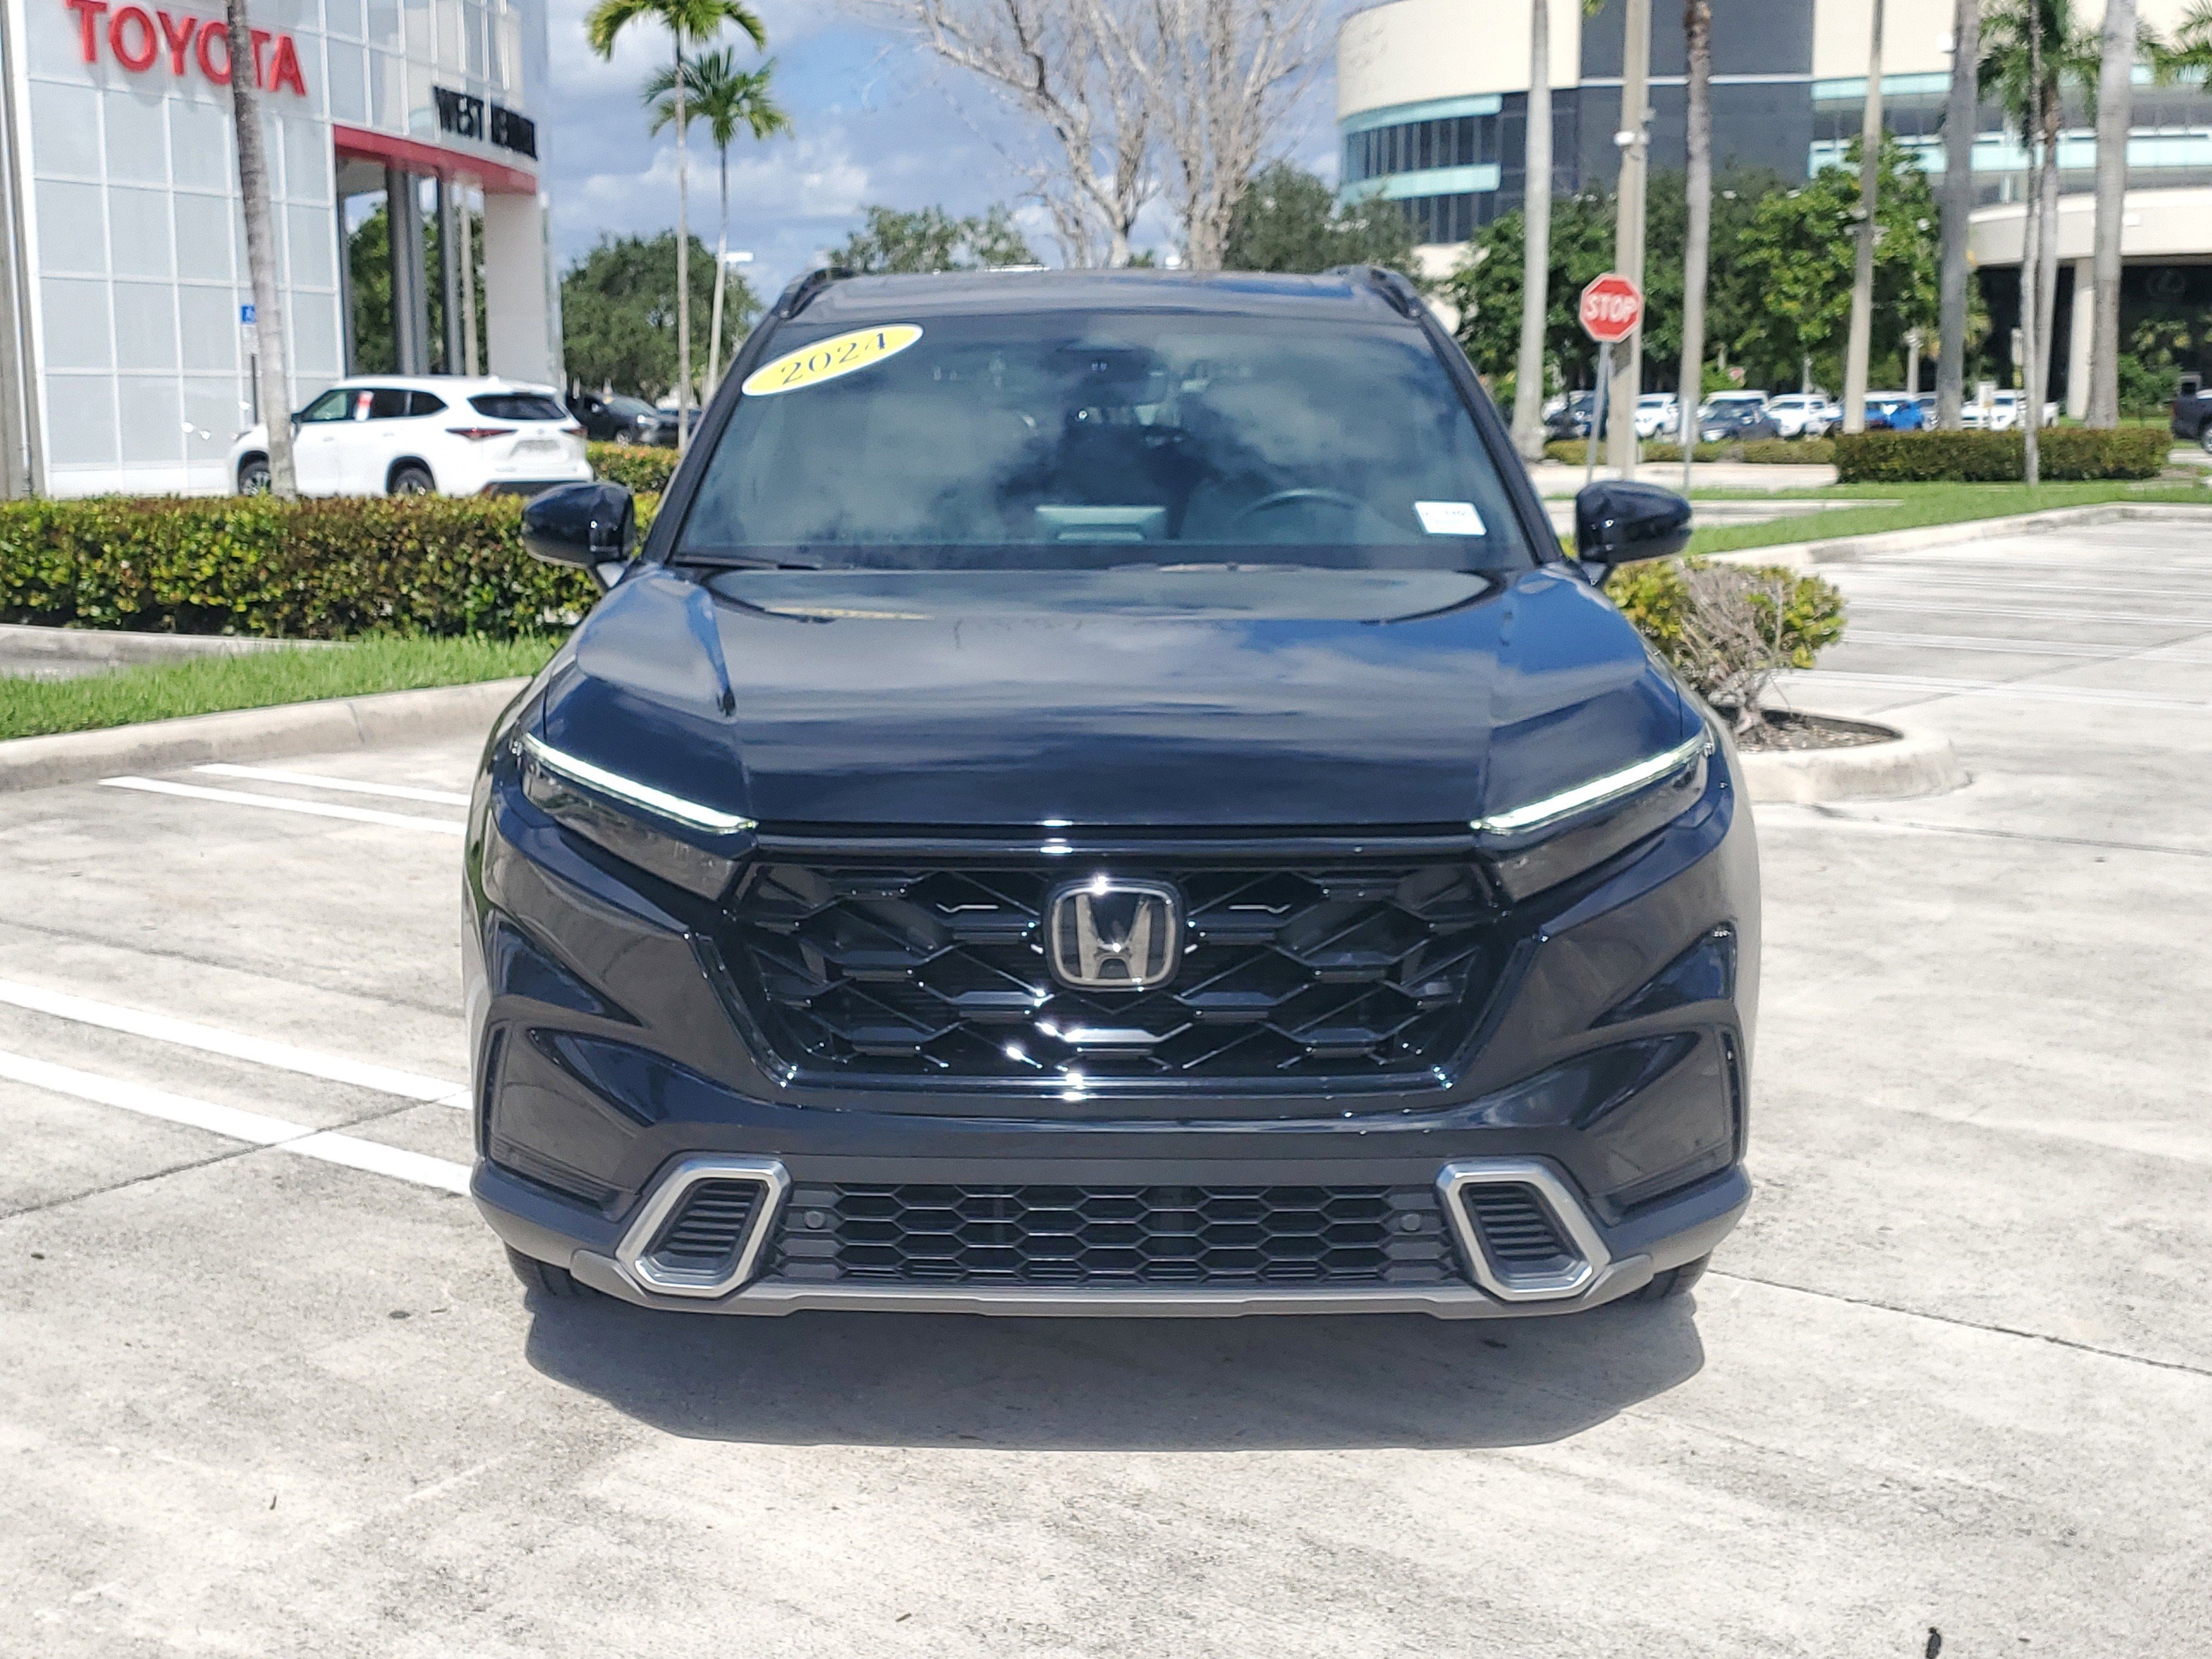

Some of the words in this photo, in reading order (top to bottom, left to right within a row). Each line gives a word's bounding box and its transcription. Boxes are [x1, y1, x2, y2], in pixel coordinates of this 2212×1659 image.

[65, 0, 306, 96] TOYOTA
[1585, 292, 1638, 323] STOP
[781, 332, 886, 385] 2024
